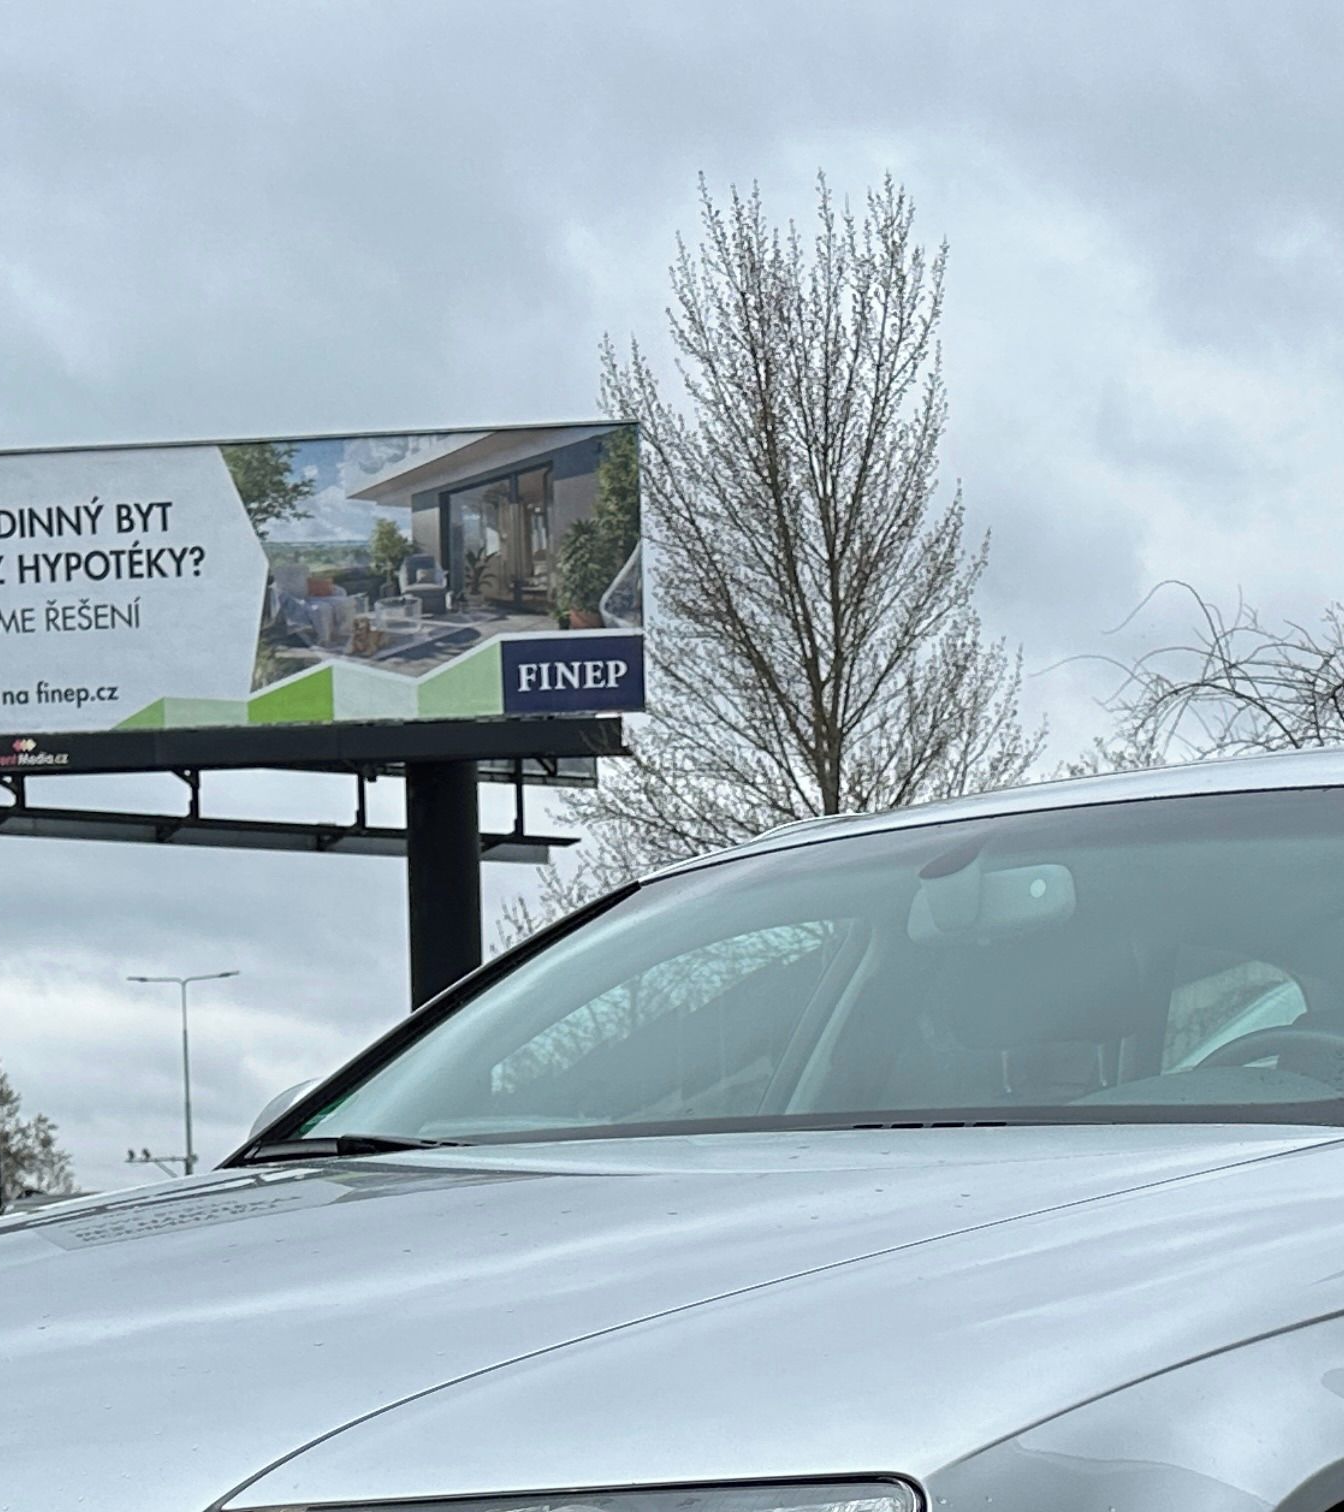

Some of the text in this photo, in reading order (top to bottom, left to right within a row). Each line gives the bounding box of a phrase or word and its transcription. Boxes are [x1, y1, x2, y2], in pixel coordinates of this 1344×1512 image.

[115, 501, 173, 534] BYT
[17, 540, 206, 584] HYPOTÉKY?
[44, 596, 142, 632] ŘEŠENÍ
[517, 659, 629, 692] FINEP
[2, 689, 29, 705] na
[35, 680, 120, 709] finep.cz
